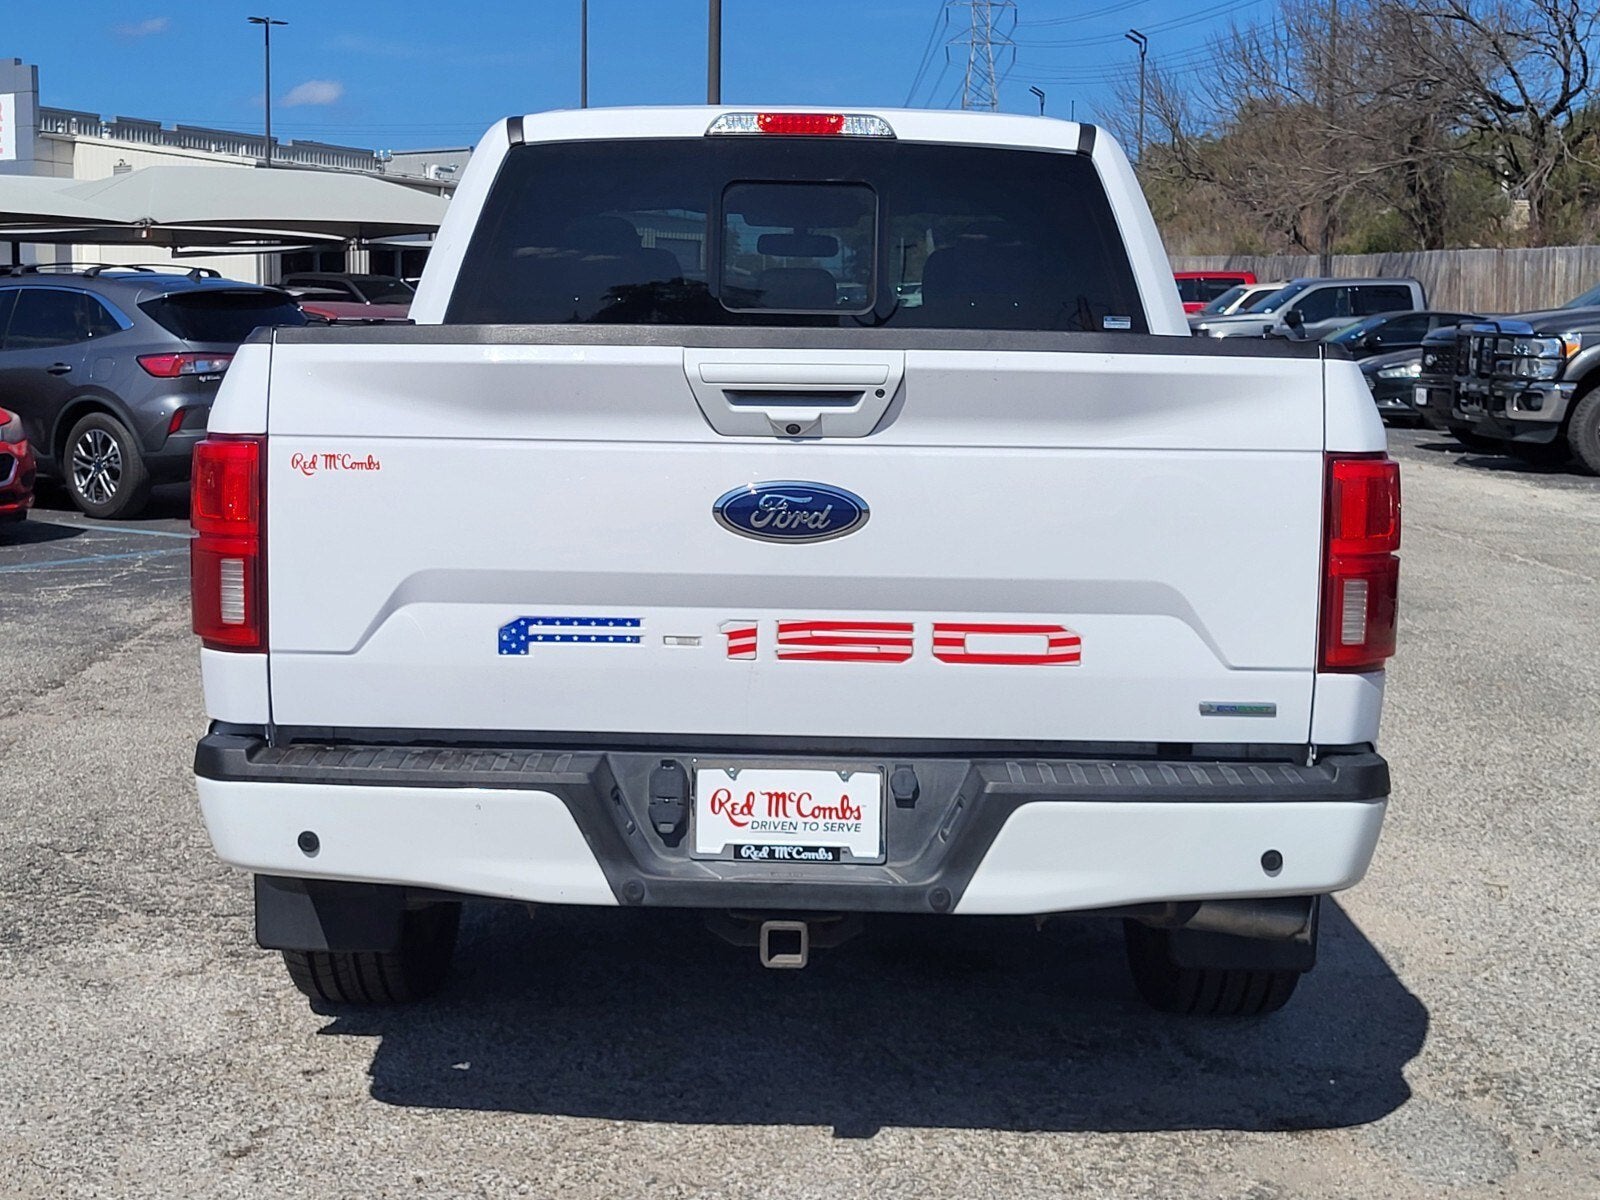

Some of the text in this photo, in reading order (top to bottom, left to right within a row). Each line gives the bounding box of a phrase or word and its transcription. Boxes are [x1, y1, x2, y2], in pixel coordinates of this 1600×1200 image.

[291, 452, 381, 476] Red McCombs
[750, 494, 833, 529] Ford
[498, 617, 1081, 666] F-150
[710, 788, 862, 827] Red McCombs
[750, 820, 862, 833] DRIVEN TO SERVE
[740, 845, 833, 861] Red McCombs
